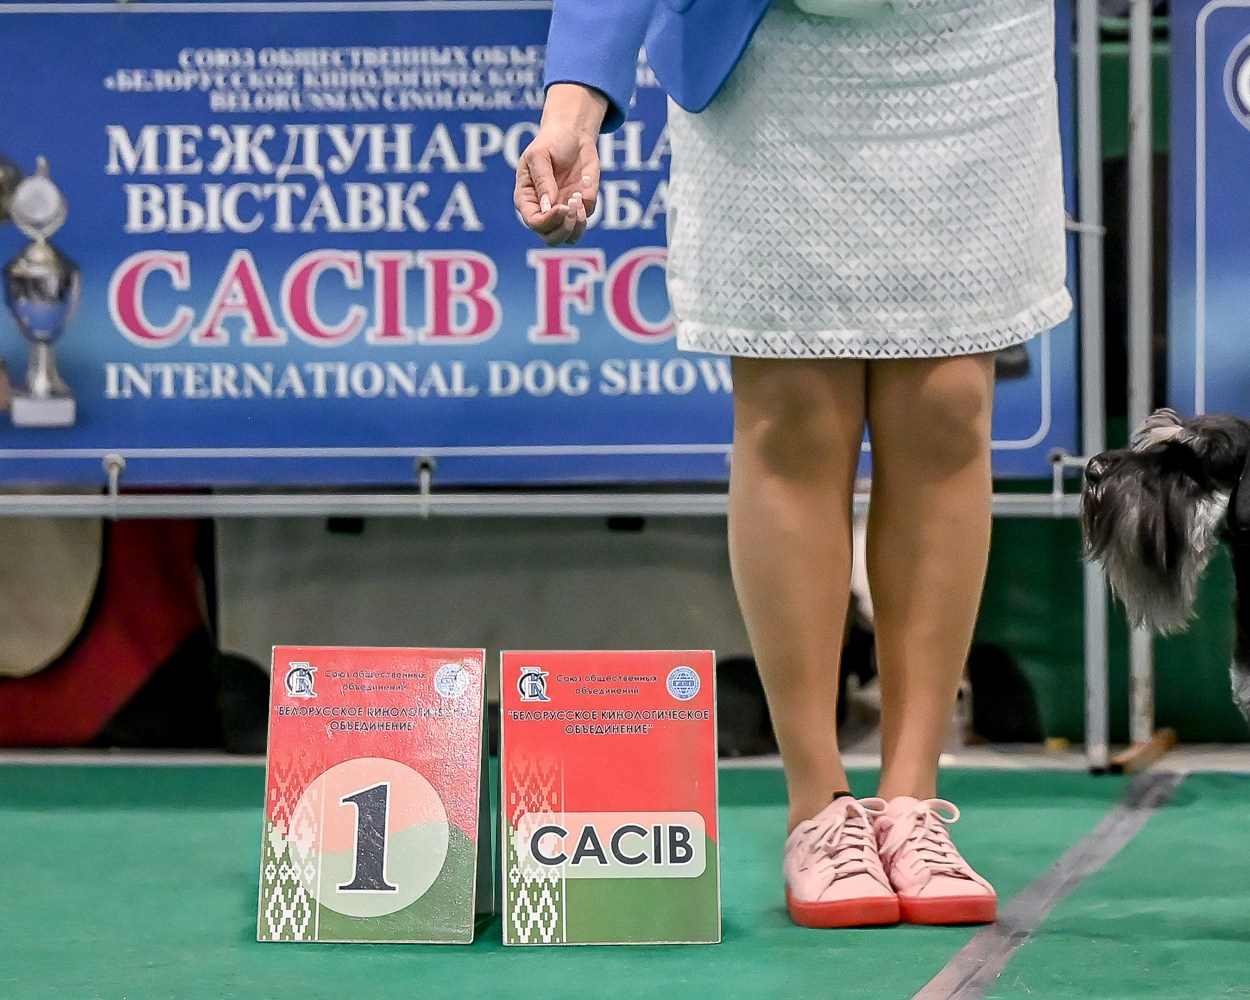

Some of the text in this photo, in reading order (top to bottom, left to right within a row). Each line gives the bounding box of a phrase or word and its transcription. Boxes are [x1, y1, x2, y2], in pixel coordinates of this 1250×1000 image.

[124, 181, 484, 233] ВЫСТАВКА
[108, 246, 676, 349] CACIB FC
[103, 360, 480, 398] INTERNATIONAL
[488, 359, 590, 397] DOG
[556, 674, 658, 684] Союз общественных
[575, 686, 639, 696] объединений
[508, 710, 709, 721] "БЕЛОРУССКОЕ КИНОЛОГИЧЕСКОЕ
[564, 723, 653, 735] ОБЪЕДИНЕНИЕ"
[338, 783, 398, 892] 1
[530, 825, 694, 866] CACIB
